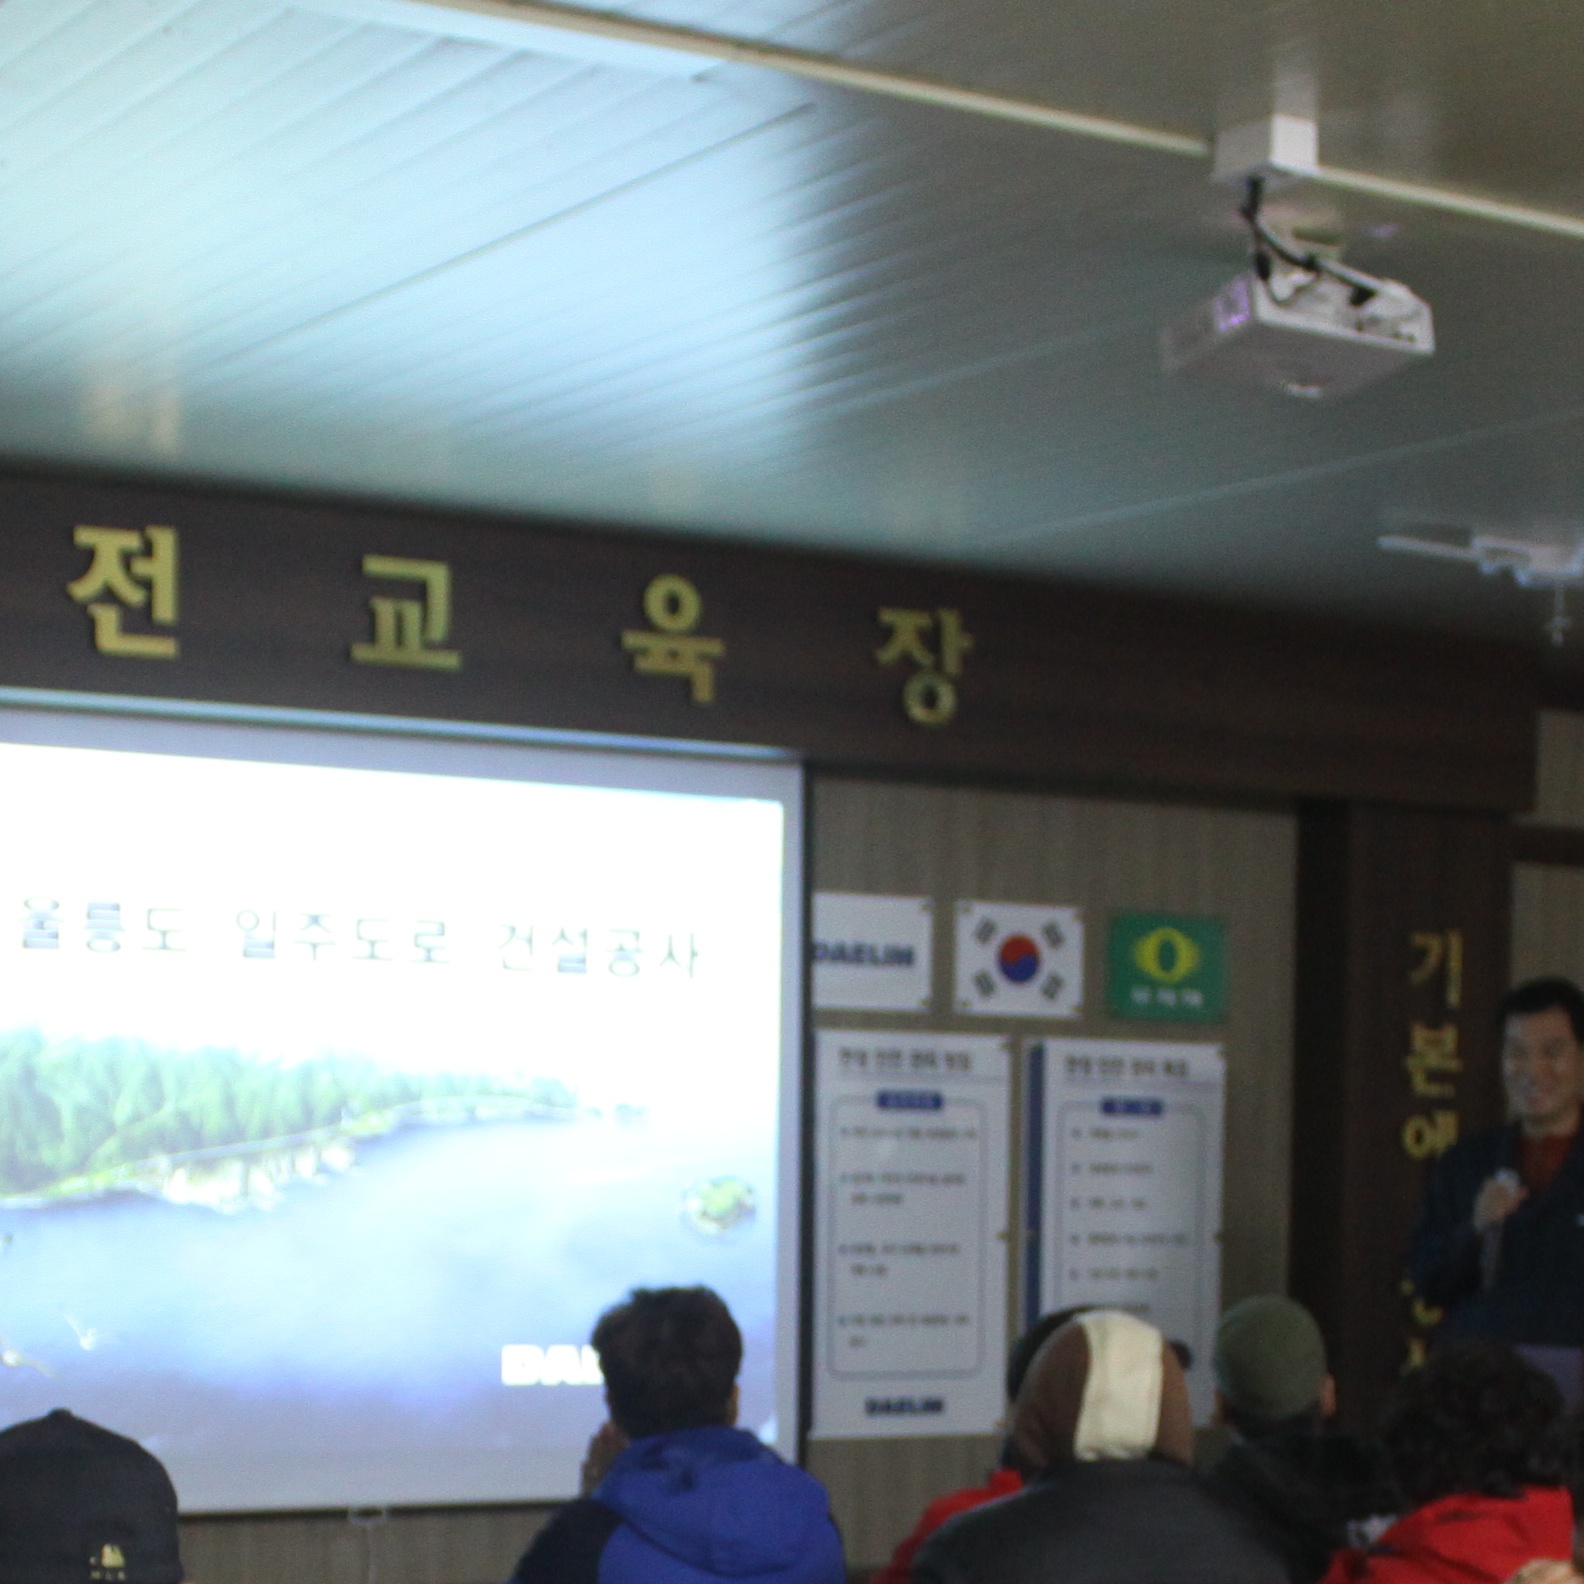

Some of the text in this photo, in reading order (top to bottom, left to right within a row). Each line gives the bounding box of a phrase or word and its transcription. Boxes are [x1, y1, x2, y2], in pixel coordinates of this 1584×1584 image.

[20, 896, 701, 979] 울릉도 일주도로 건설공사
[812, 941, 915, 966] DAELIM
[1402, 929, 1464, 1162] 기본에
